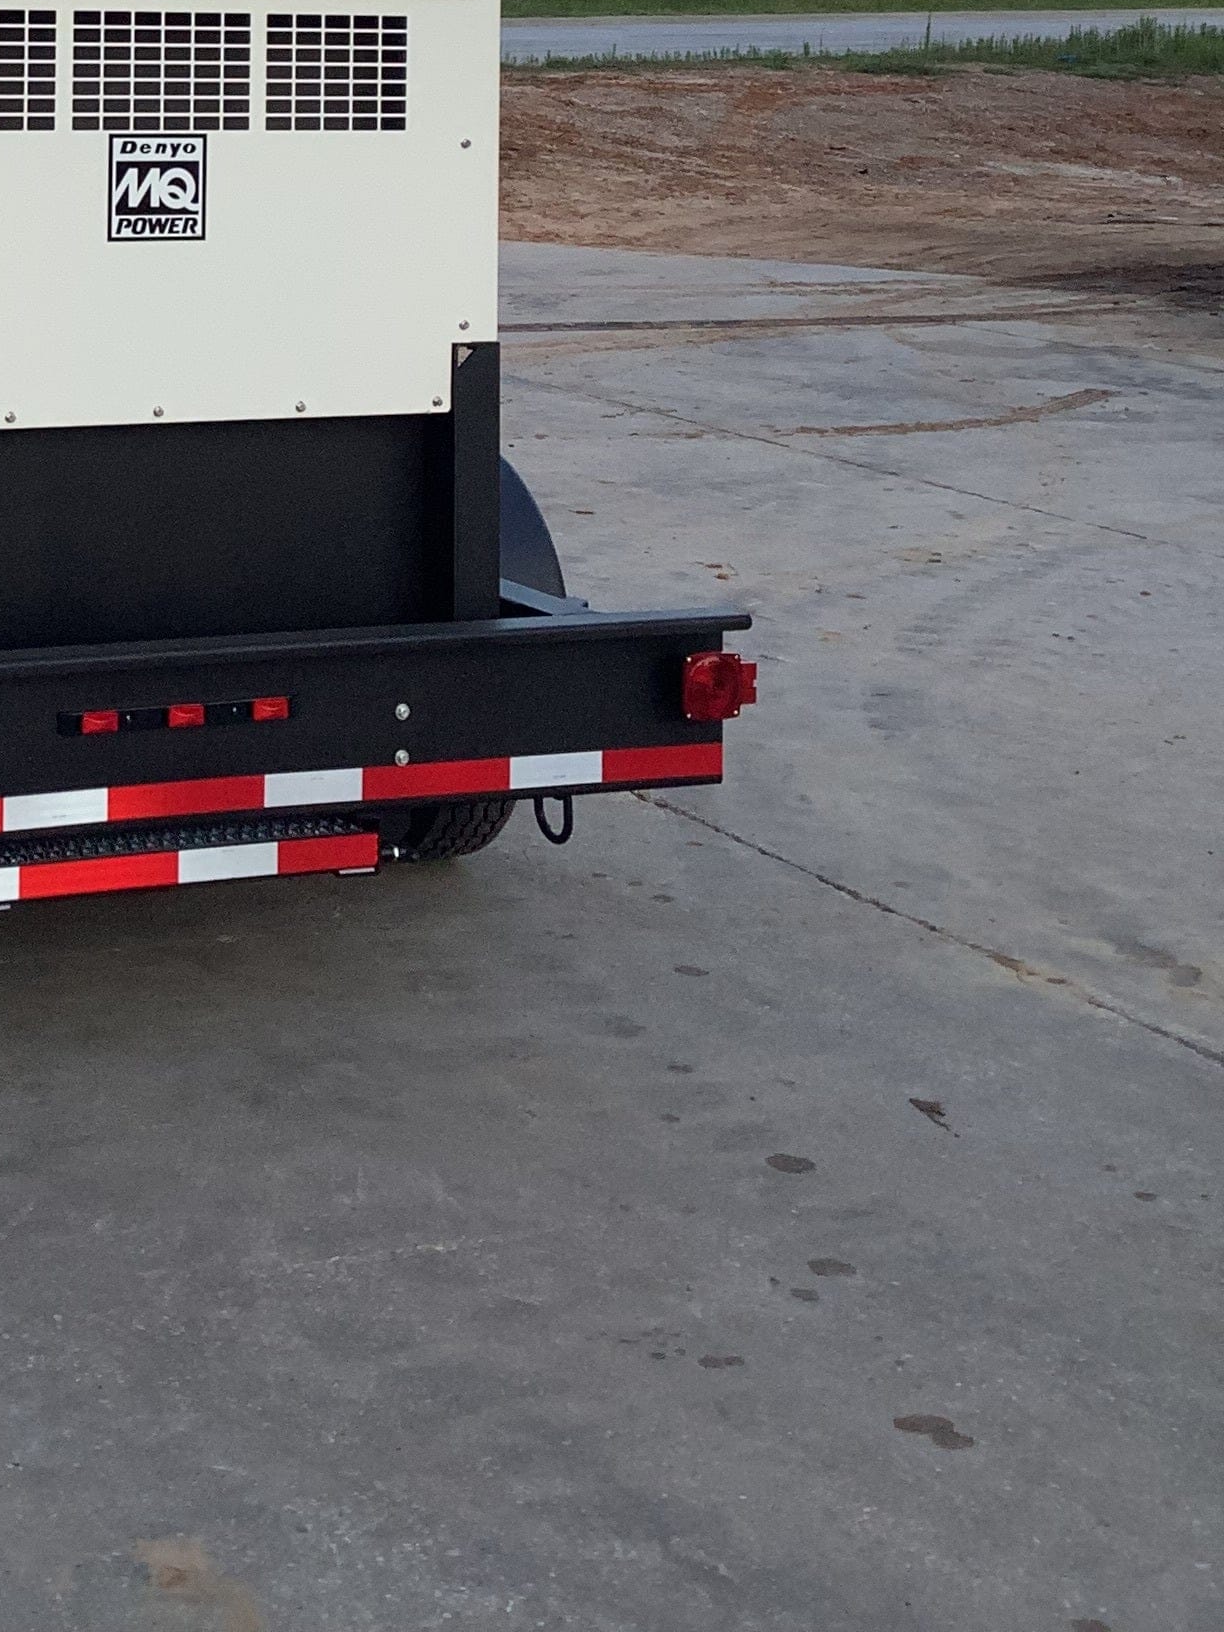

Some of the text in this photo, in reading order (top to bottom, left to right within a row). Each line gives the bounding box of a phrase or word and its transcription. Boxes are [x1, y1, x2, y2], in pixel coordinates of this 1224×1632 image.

[120, 140, 196, 158] Denyo
[116, 167, 199, 212] MQ
[115, 217, 198, 235] POWER
